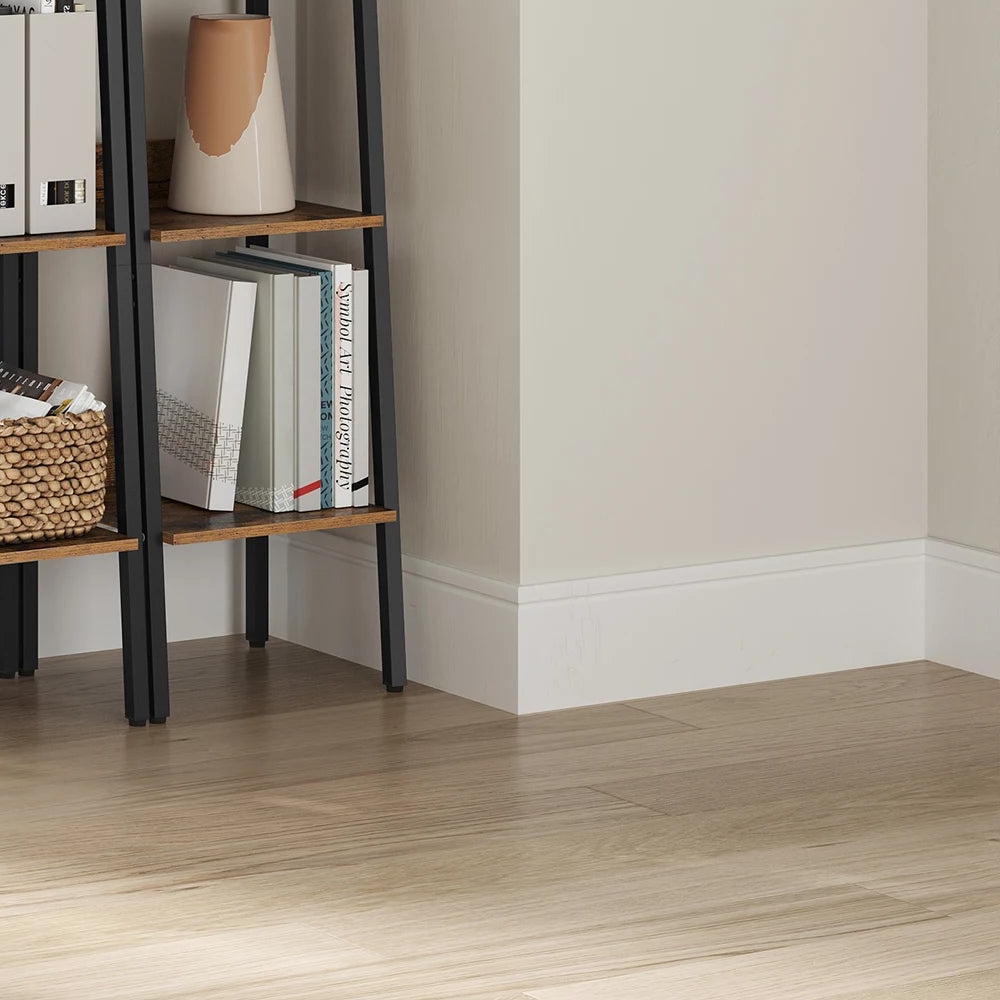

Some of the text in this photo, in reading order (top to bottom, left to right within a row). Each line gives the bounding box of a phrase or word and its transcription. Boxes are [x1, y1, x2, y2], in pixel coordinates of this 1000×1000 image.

[335, 281, 353, 490] Symbol Art Photography
